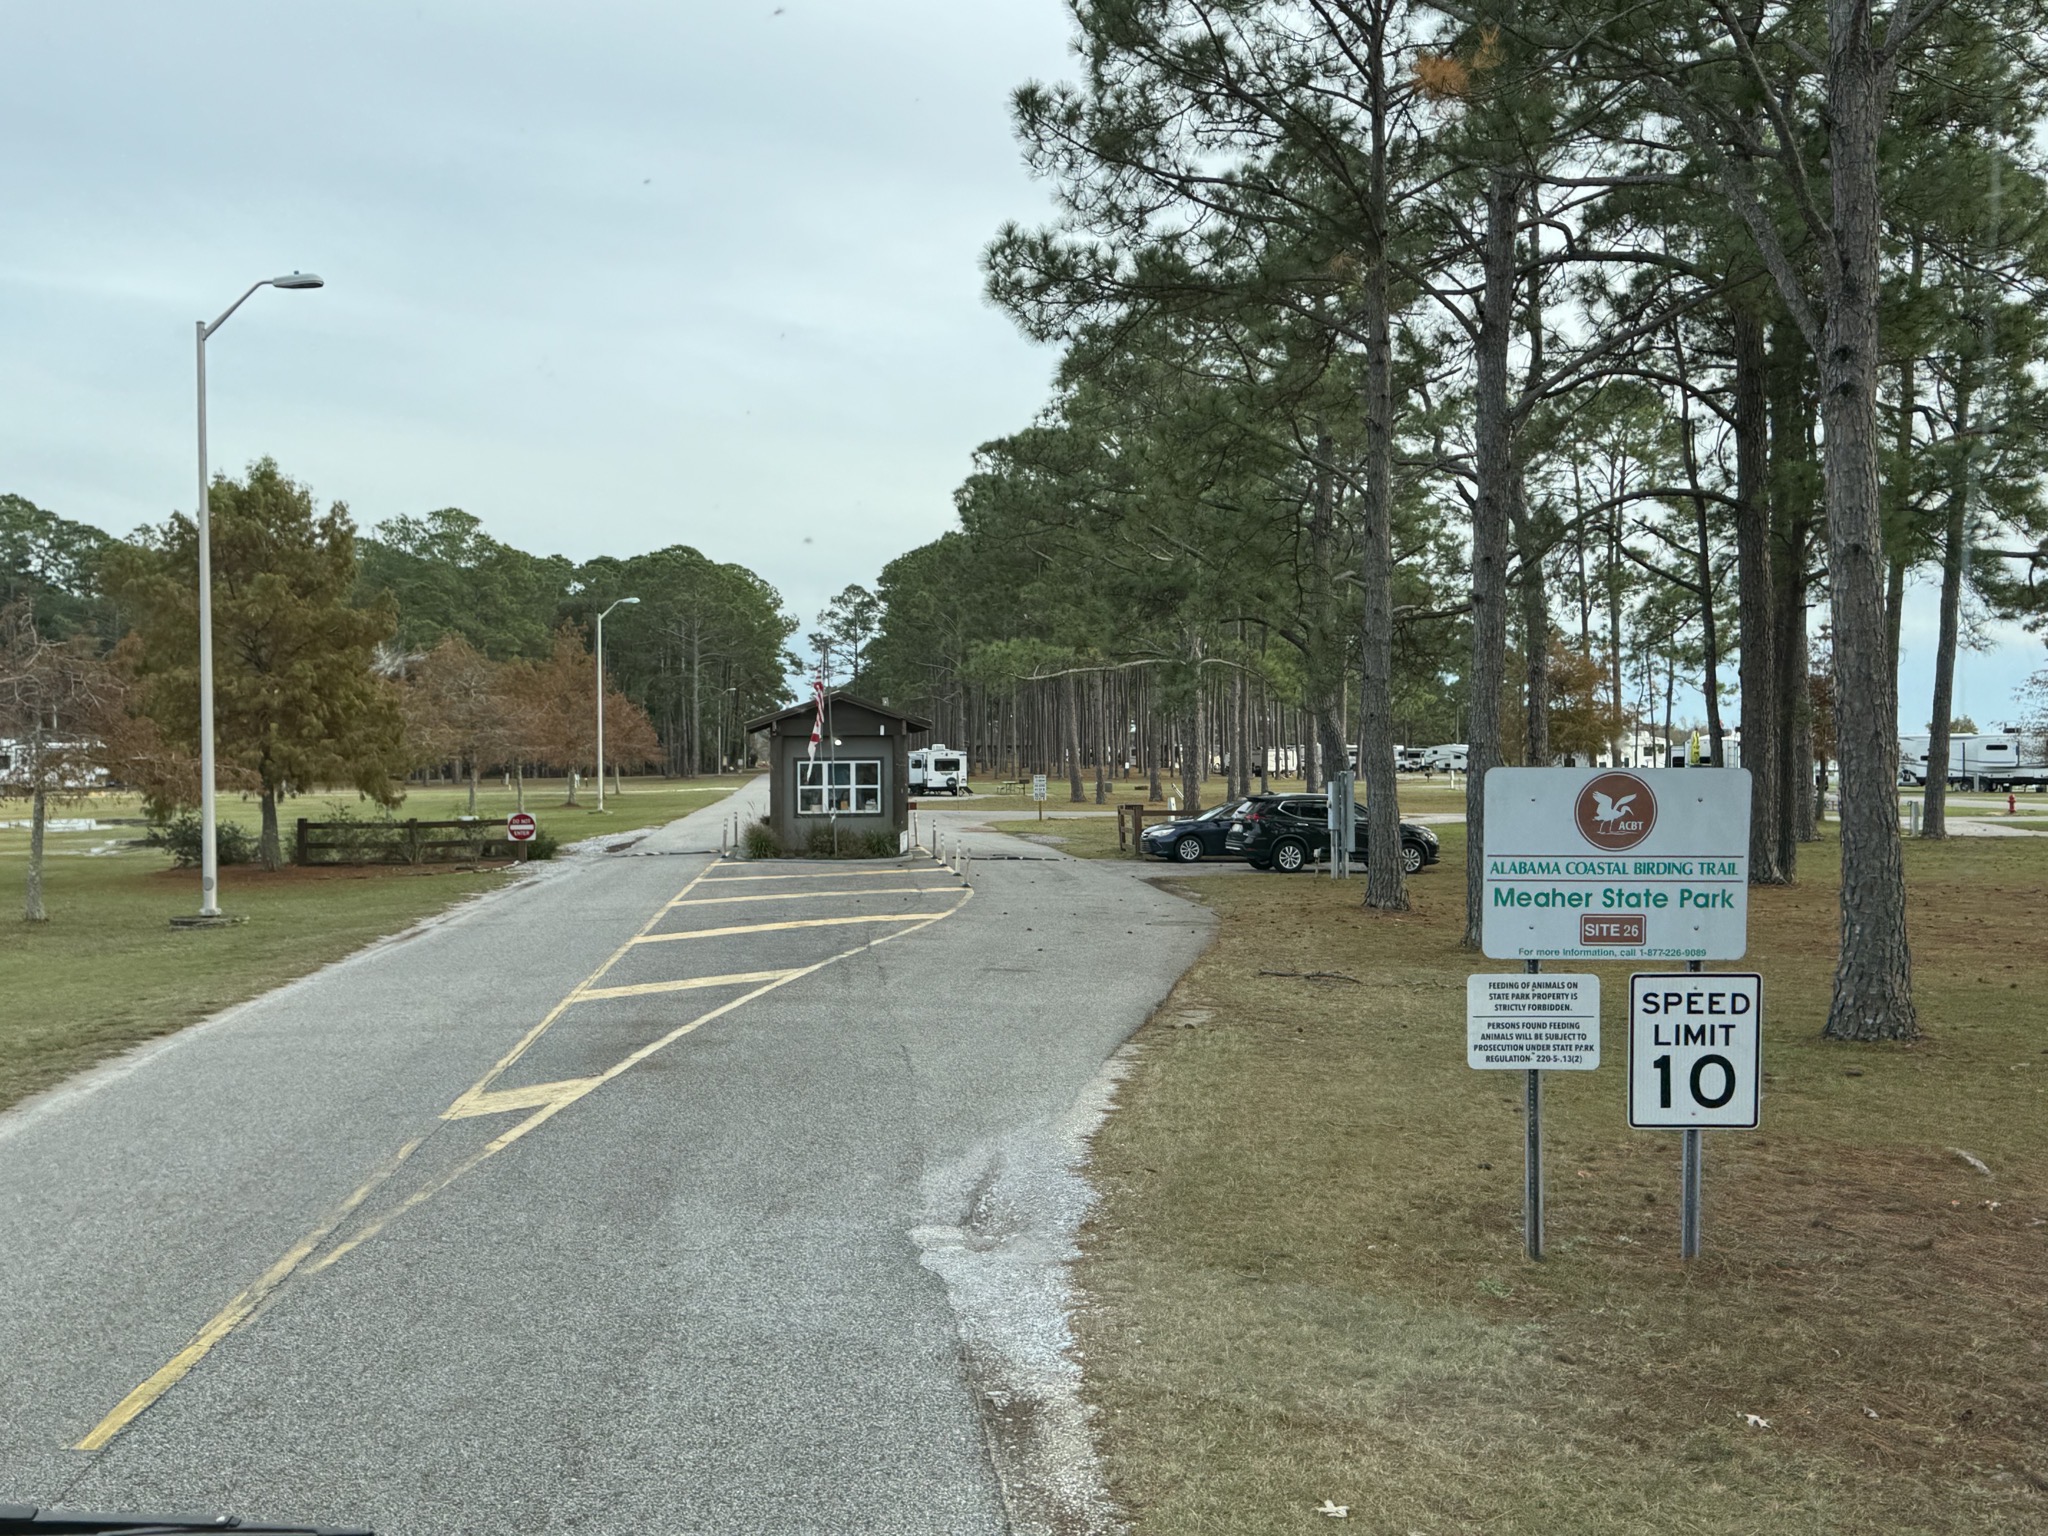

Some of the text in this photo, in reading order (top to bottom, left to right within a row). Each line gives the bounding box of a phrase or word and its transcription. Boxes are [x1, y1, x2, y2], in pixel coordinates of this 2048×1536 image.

[1618, 821, 1644, 831] ACBT
[1490, 861, 1738, 875] ALABAMA COASTAL BIRDING TRAIL
[1494, 887, 1735, 909] Meaher State Park
[1584, 923, 1639, 937] SITE 26
[1518, 948, 1533, 956] For
[1536, 948, 1560, 956] more
[1620, 948, 1636, 957] call
[1488, 982, 1519, 990] FEEDING
[1520, 982, 1531, 990] OF
[1531, 982, 1565, 990] ANIMALS
[1494, 1003, 1573, 1011] STRICTLY FORBIDDEN.
[1642, 992, 1751, 1015] SPEED
[1487, 1022, 1580, 1030] PERSONS FOUND FEEDING
[1654, 1024, 1736, 1046] LIMIT
[1473, 1044, 1524, 1052] PROSECUTION
[1525, 1044, 1551, 1052] UNDER
[1552, 1044, 1572, 1052] STATE
[1653, 1054, 1736, 1109] 10
